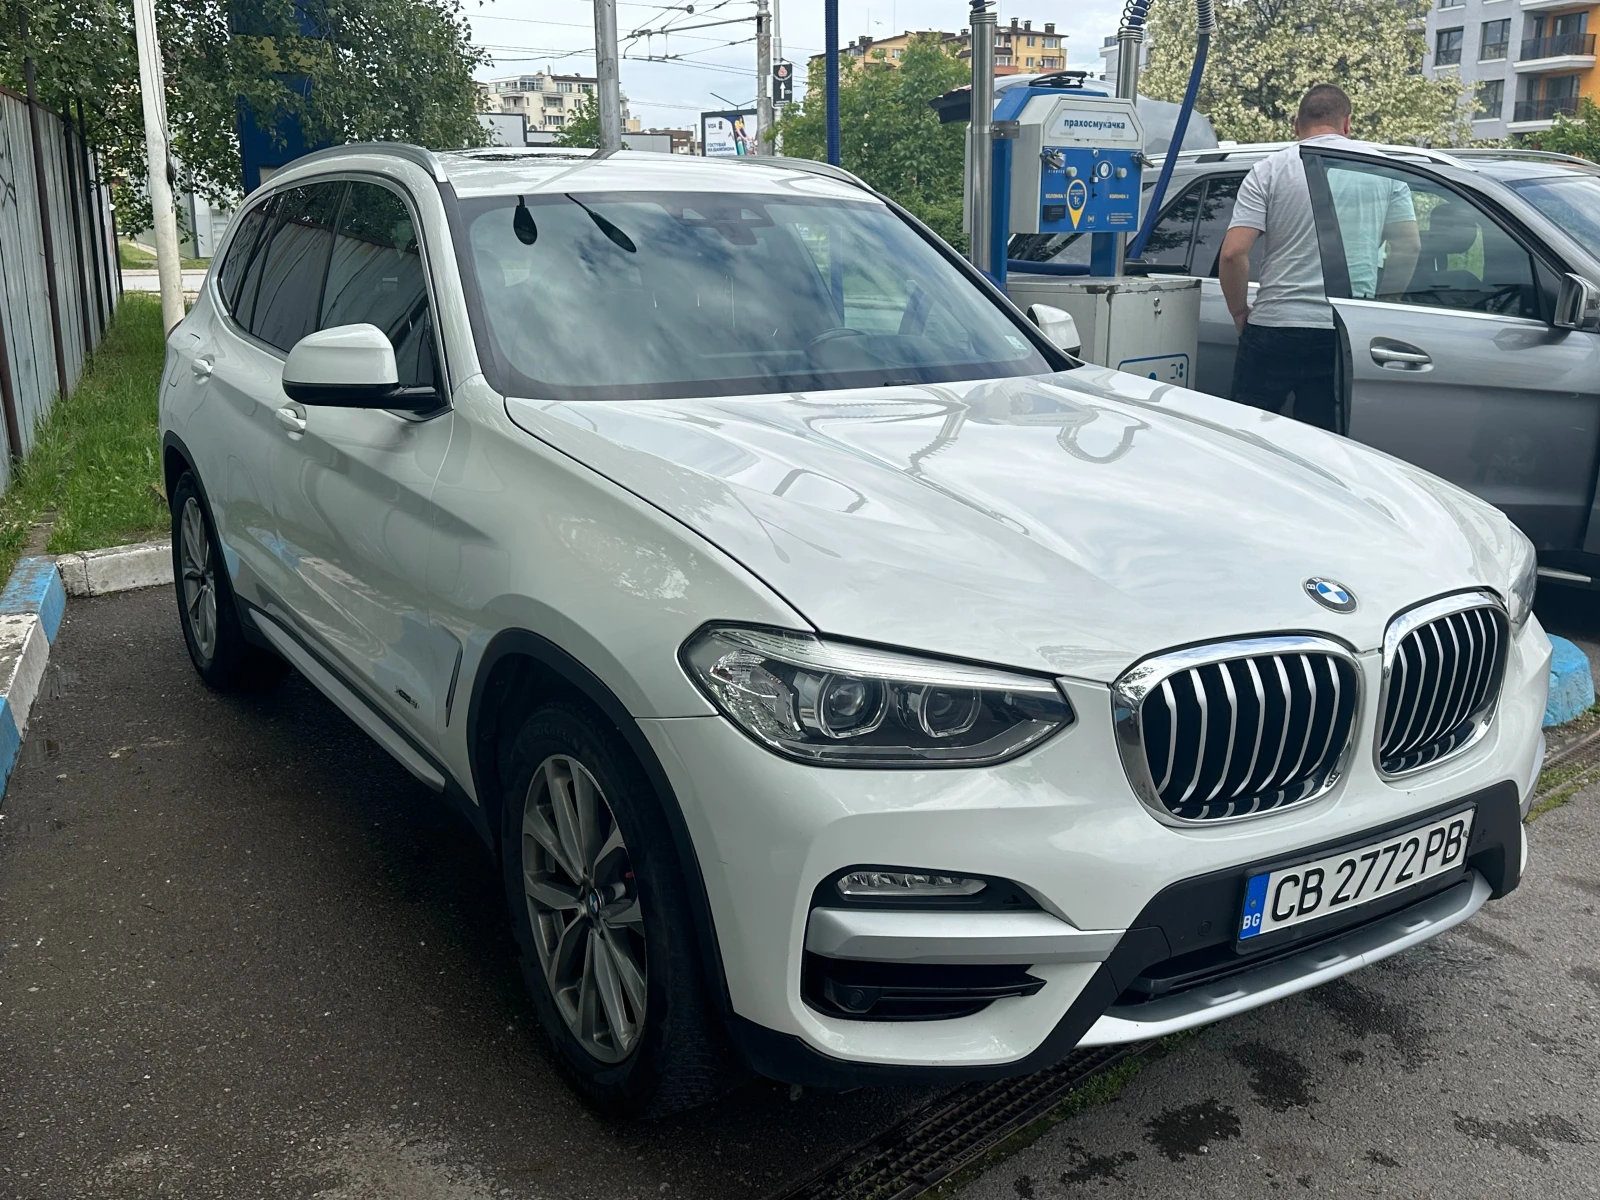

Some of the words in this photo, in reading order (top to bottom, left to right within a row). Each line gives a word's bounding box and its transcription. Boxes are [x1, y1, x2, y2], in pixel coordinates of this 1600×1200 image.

[1064, 119, 1125, 130] прахосмукачка
[1271, 867, 1325, 922] CB
[1329, 837, 1420, 907] 2772
[1420, 819, 1465, 875] PB
[1242, 912, 1261, 930] BG
